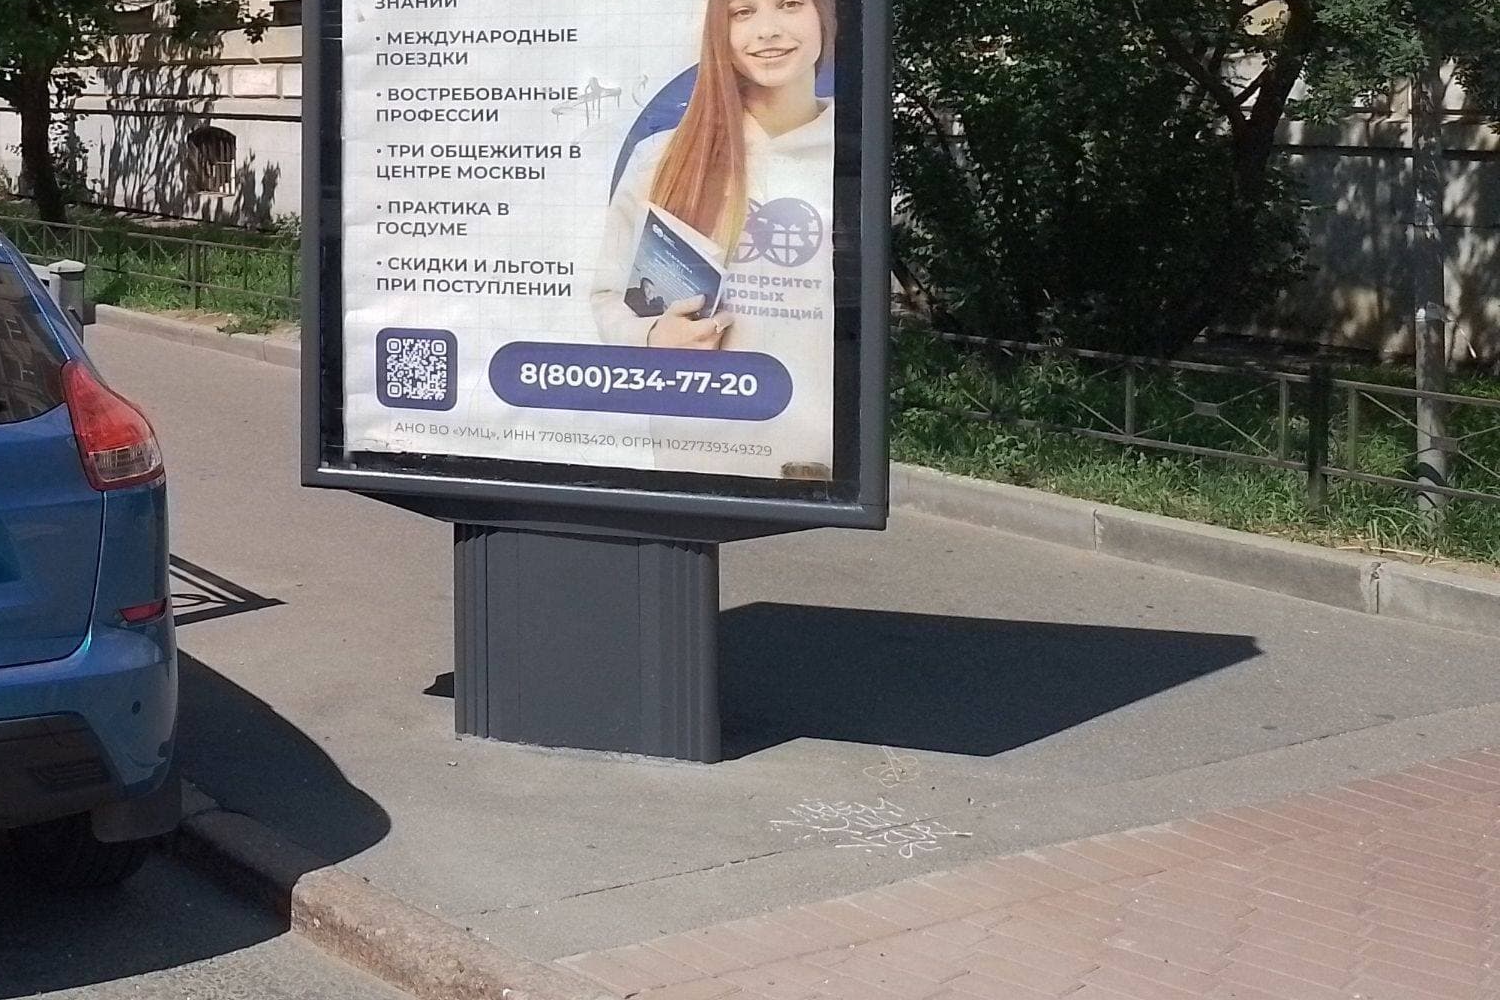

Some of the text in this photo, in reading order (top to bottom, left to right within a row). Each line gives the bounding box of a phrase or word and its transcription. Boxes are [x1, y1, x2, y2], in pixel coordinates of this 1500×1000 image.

[387, 28, 578, 47] МЕЖДУНАРОДНЫЕ
[376, 51, 469, 68] ПОЕЗДКИ
[387, 87, 579, 101] ВОСТРЕБОВАННЫЕ
[376, 108, 499, 123] ПРОФЕССИИ
[387, 144, 582, 161] ТРИ ОБЩЕЖИТИЯ В
[376, 165, 546, 181] ЦЕНТРЕ МОСКВЫ
[388, 200, 510, 216] ПРАКТИКА В
[376, 221, 468, 237] ГОСДУМЕ
[387, 256, 575, 276] СКИДКИ И ЛЬГОТЫ
[376, 277, 572, 297] ПРИ ПОСТУПЛЕНИИ
[726, 273, 823, 290] иверситет
[725, 288, 785, 303] ровых
[722, 303, 823, 321] вилизаций
[520, 363, 758, 397] 8(800)234-77-20
[394, 422, 773, 457] АНО ВО «УМЦ», ИНН 7708113420, ОГРН 1027739349329
